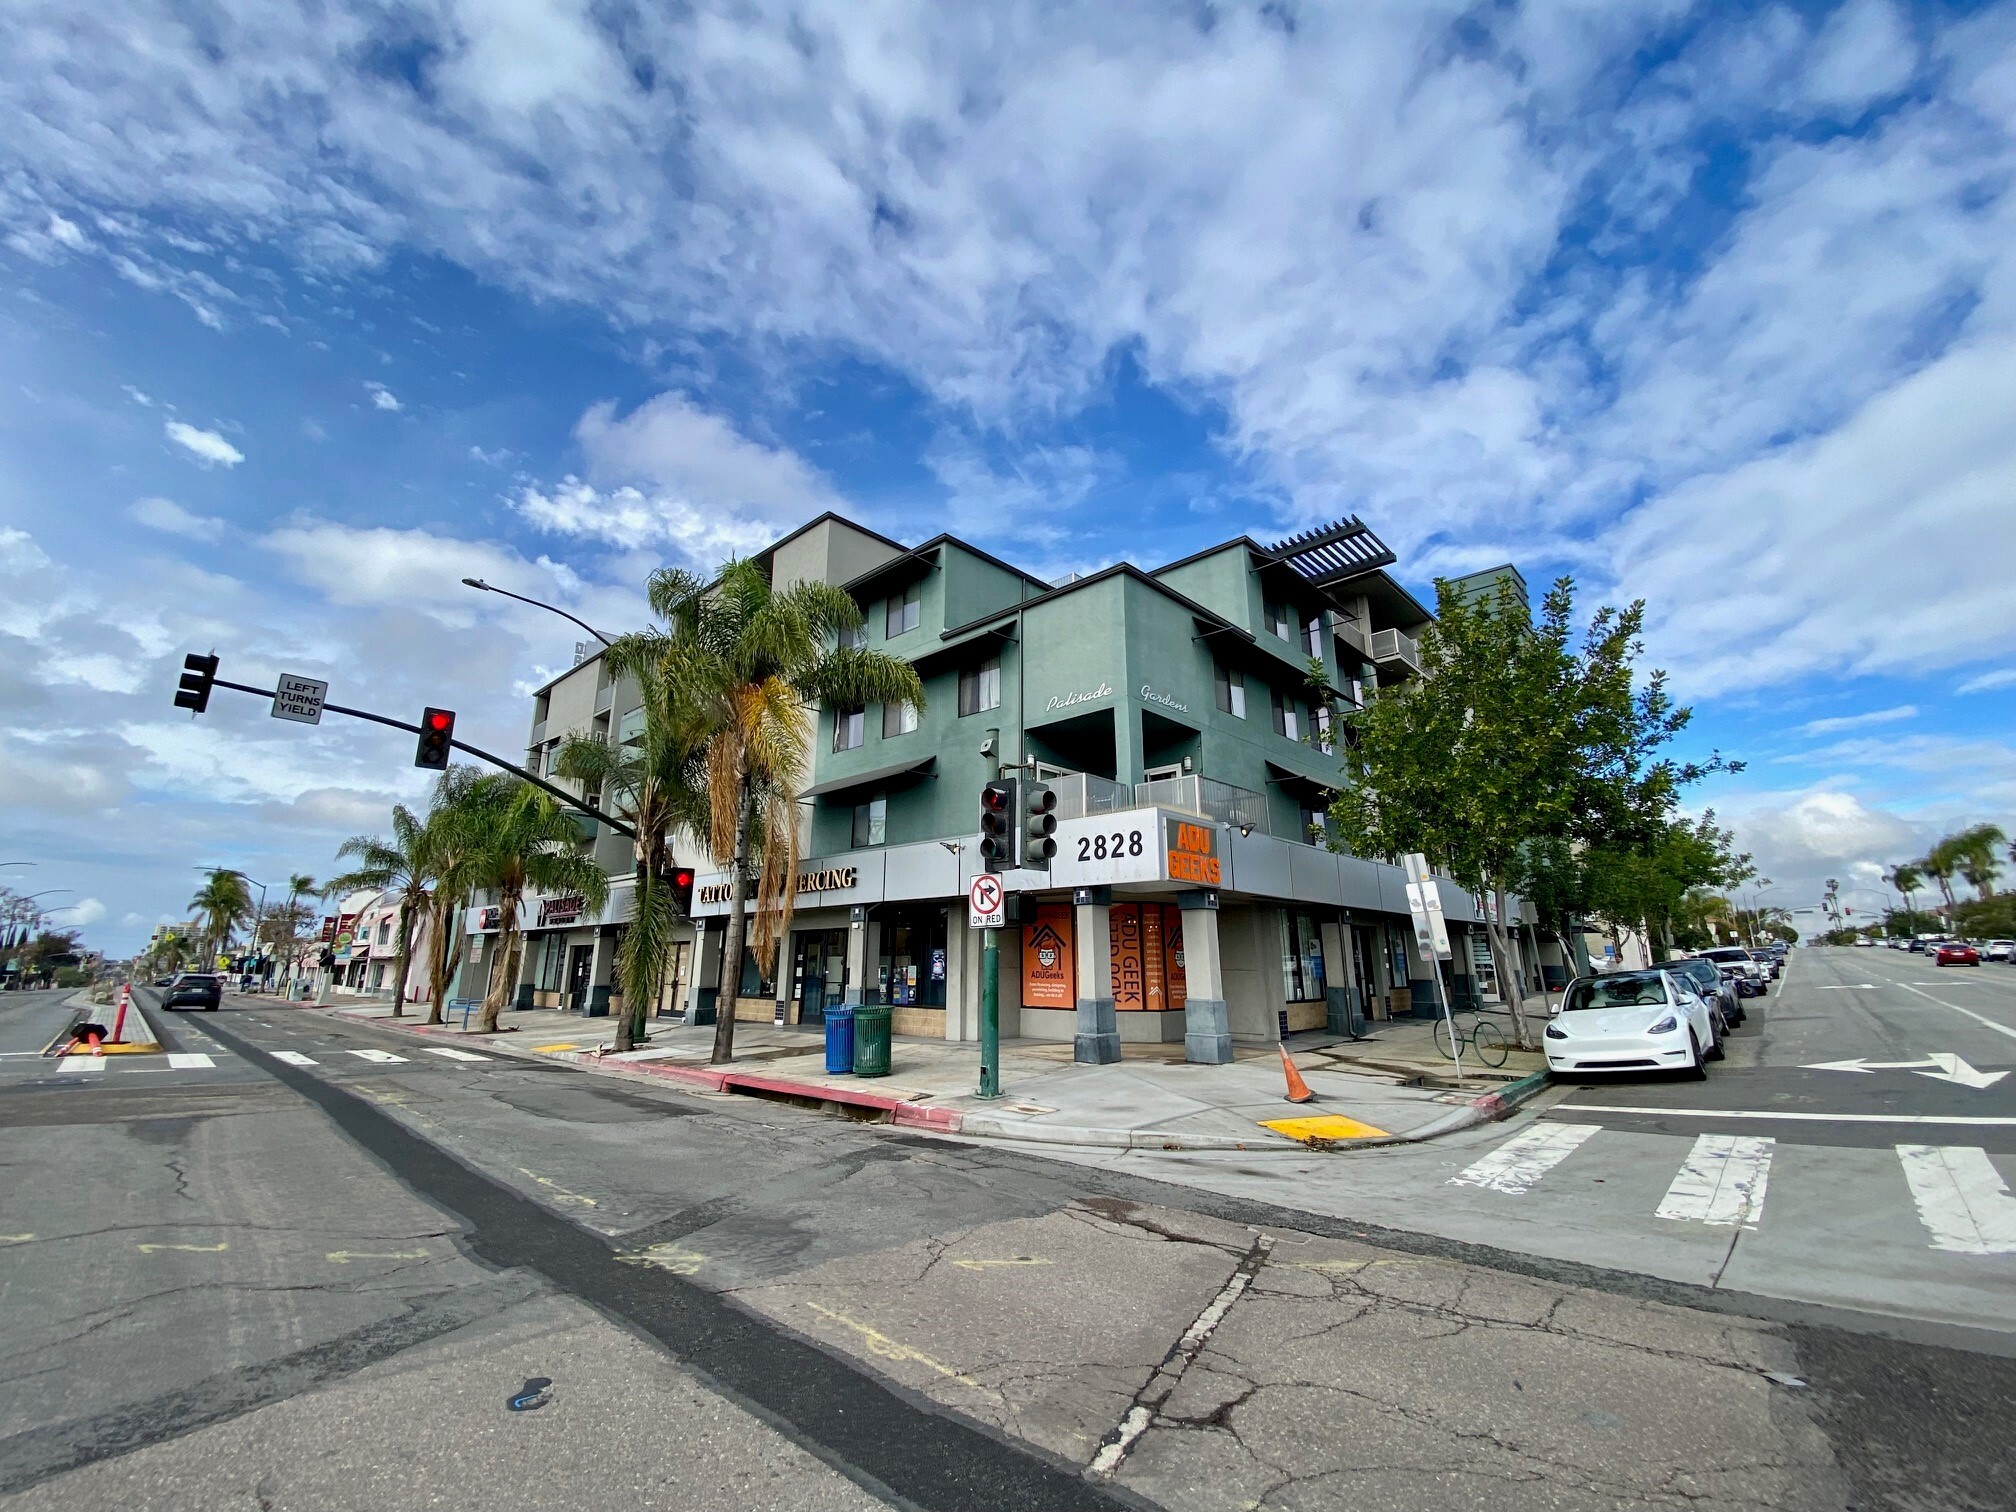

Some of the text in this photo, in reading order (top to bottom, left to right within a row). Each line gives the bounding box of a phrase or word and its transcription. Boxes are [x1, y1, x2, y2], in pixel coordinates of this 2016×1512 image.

[280, 690, 321, 706] TURNS
[286, 681, 320, 695] LEFT
[1046, 682, 1189, 713] Palisade Gardens
[280, 702, 317, 717] YIELD
[1077, 830, 1143, 862] 2828
[1177, 822, 1211, 855] ADU
[1168, 850, 1222, 885] GEEKS
[697, 866, 855, 904] TATTO ERCING
[972, 914, 1001, 925] ON RED
[1031, 970, 1065, 980] ADUGeeks
[1123, 956, 1140, 1003] GEEK
